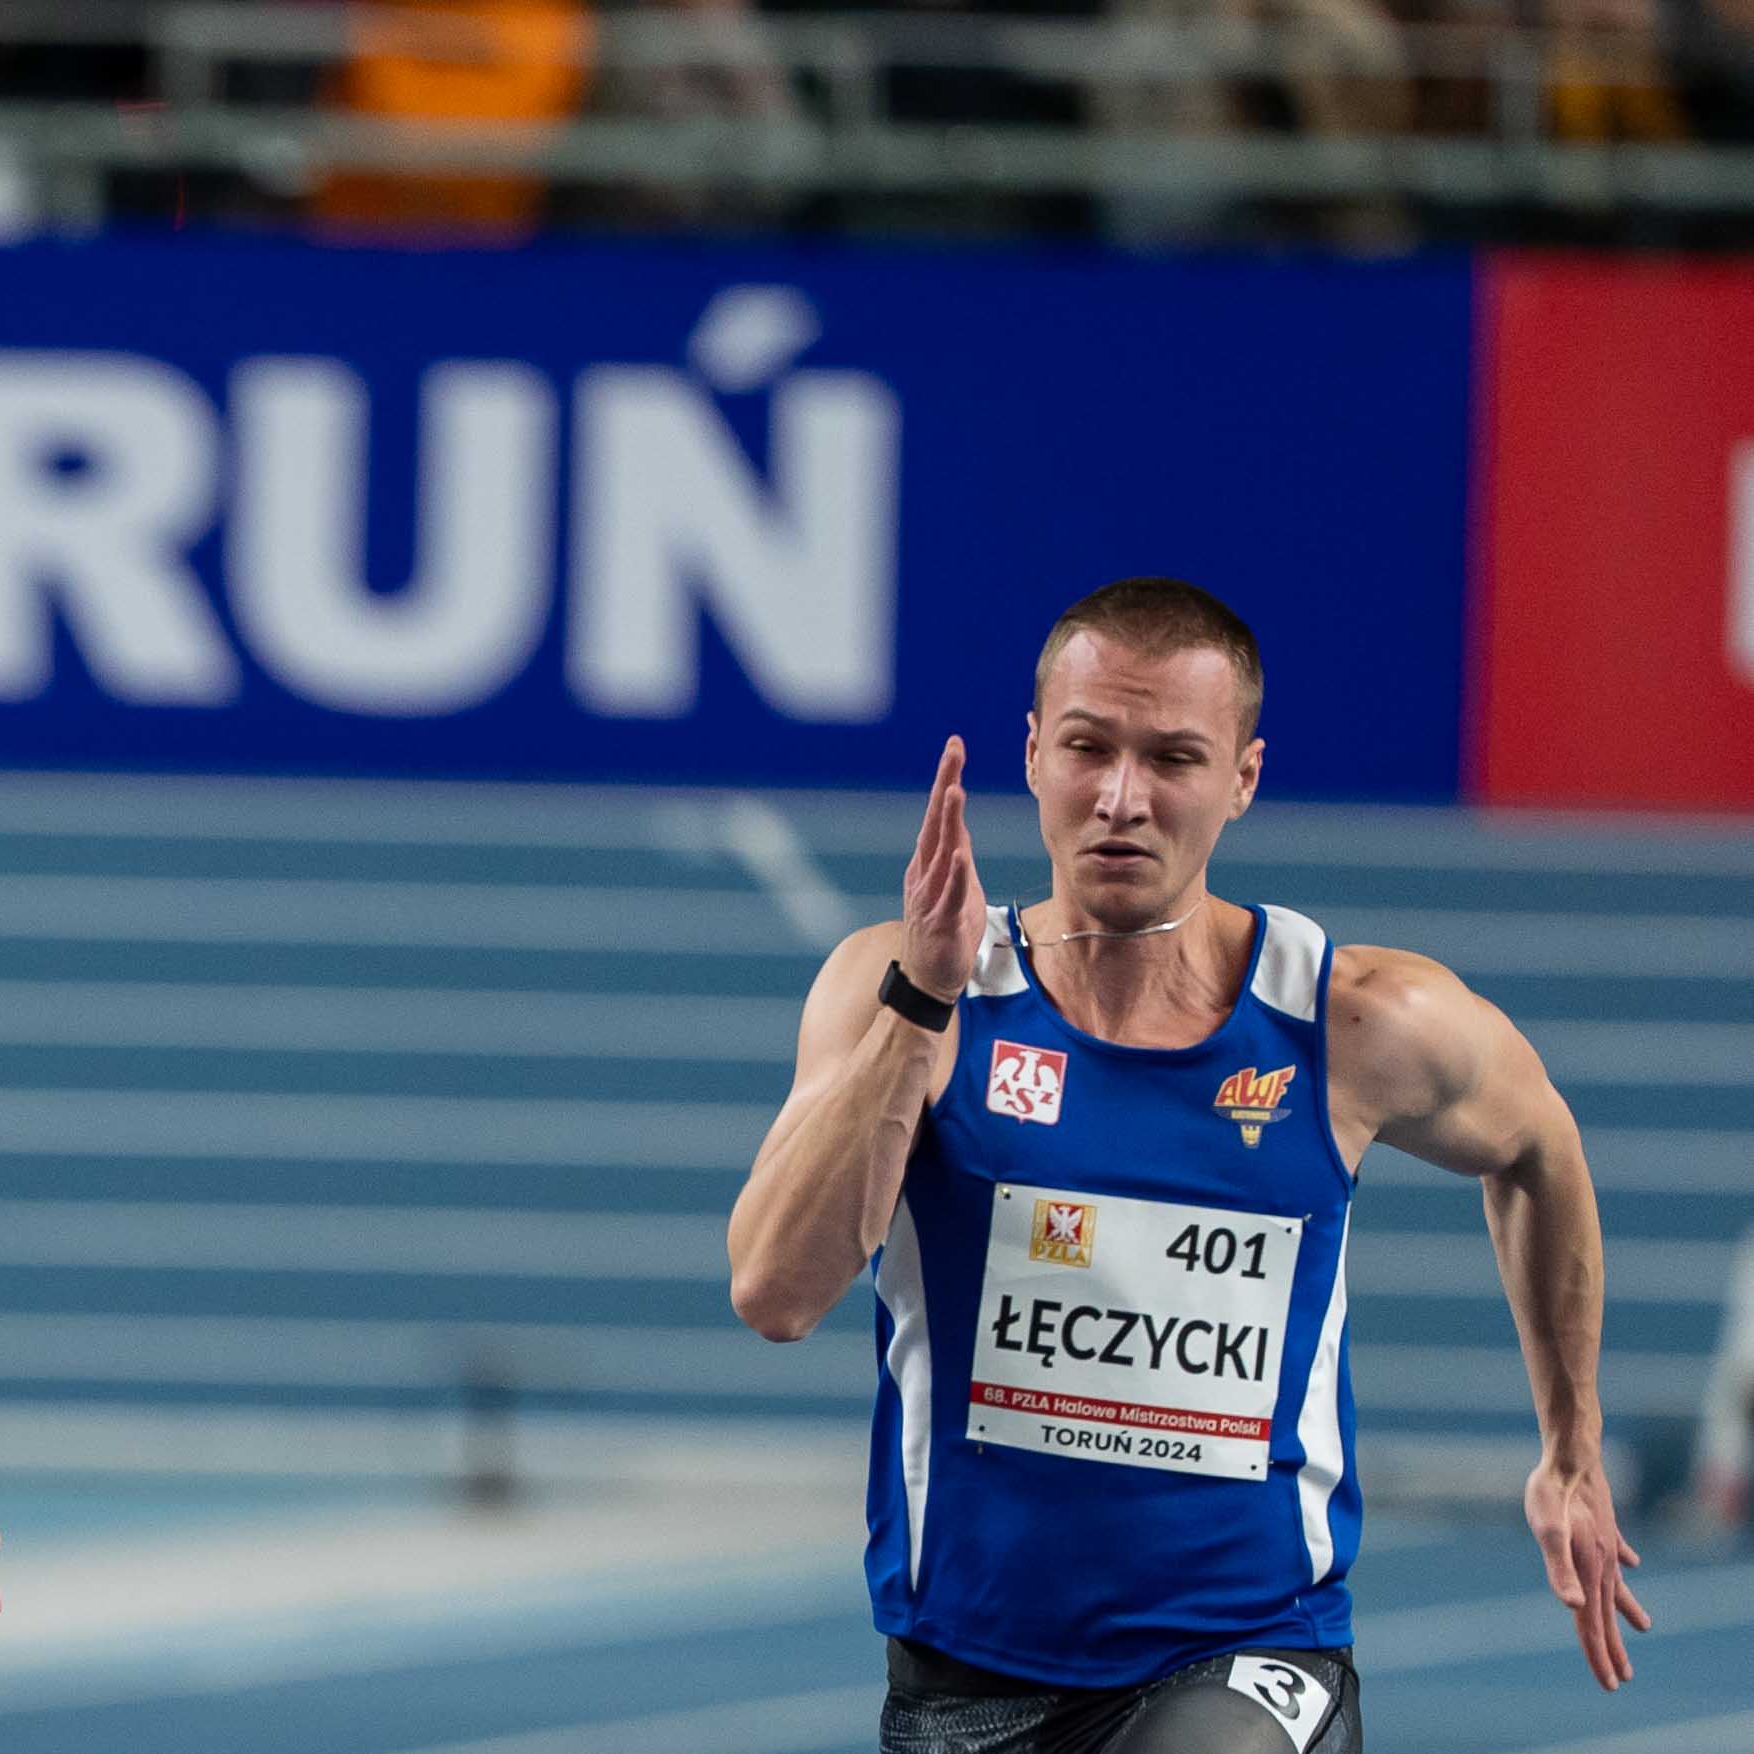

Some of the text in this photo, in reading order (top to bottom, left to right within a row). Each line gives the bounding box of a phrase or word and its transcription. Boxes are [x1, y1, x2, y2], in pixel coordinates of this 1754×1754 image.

[1166, 1224, 1267, 1279] 401
[993, 1295, 1268, 1381] ŁĘCZYCKI
[983, 1387, 1261, 1436] 68. PZLA Halowe Mistrzostwa Polski
[1041, 1425, 1203, 1463] TORUŃ 2024
[1253, 1664, 1306, 1720] 3
